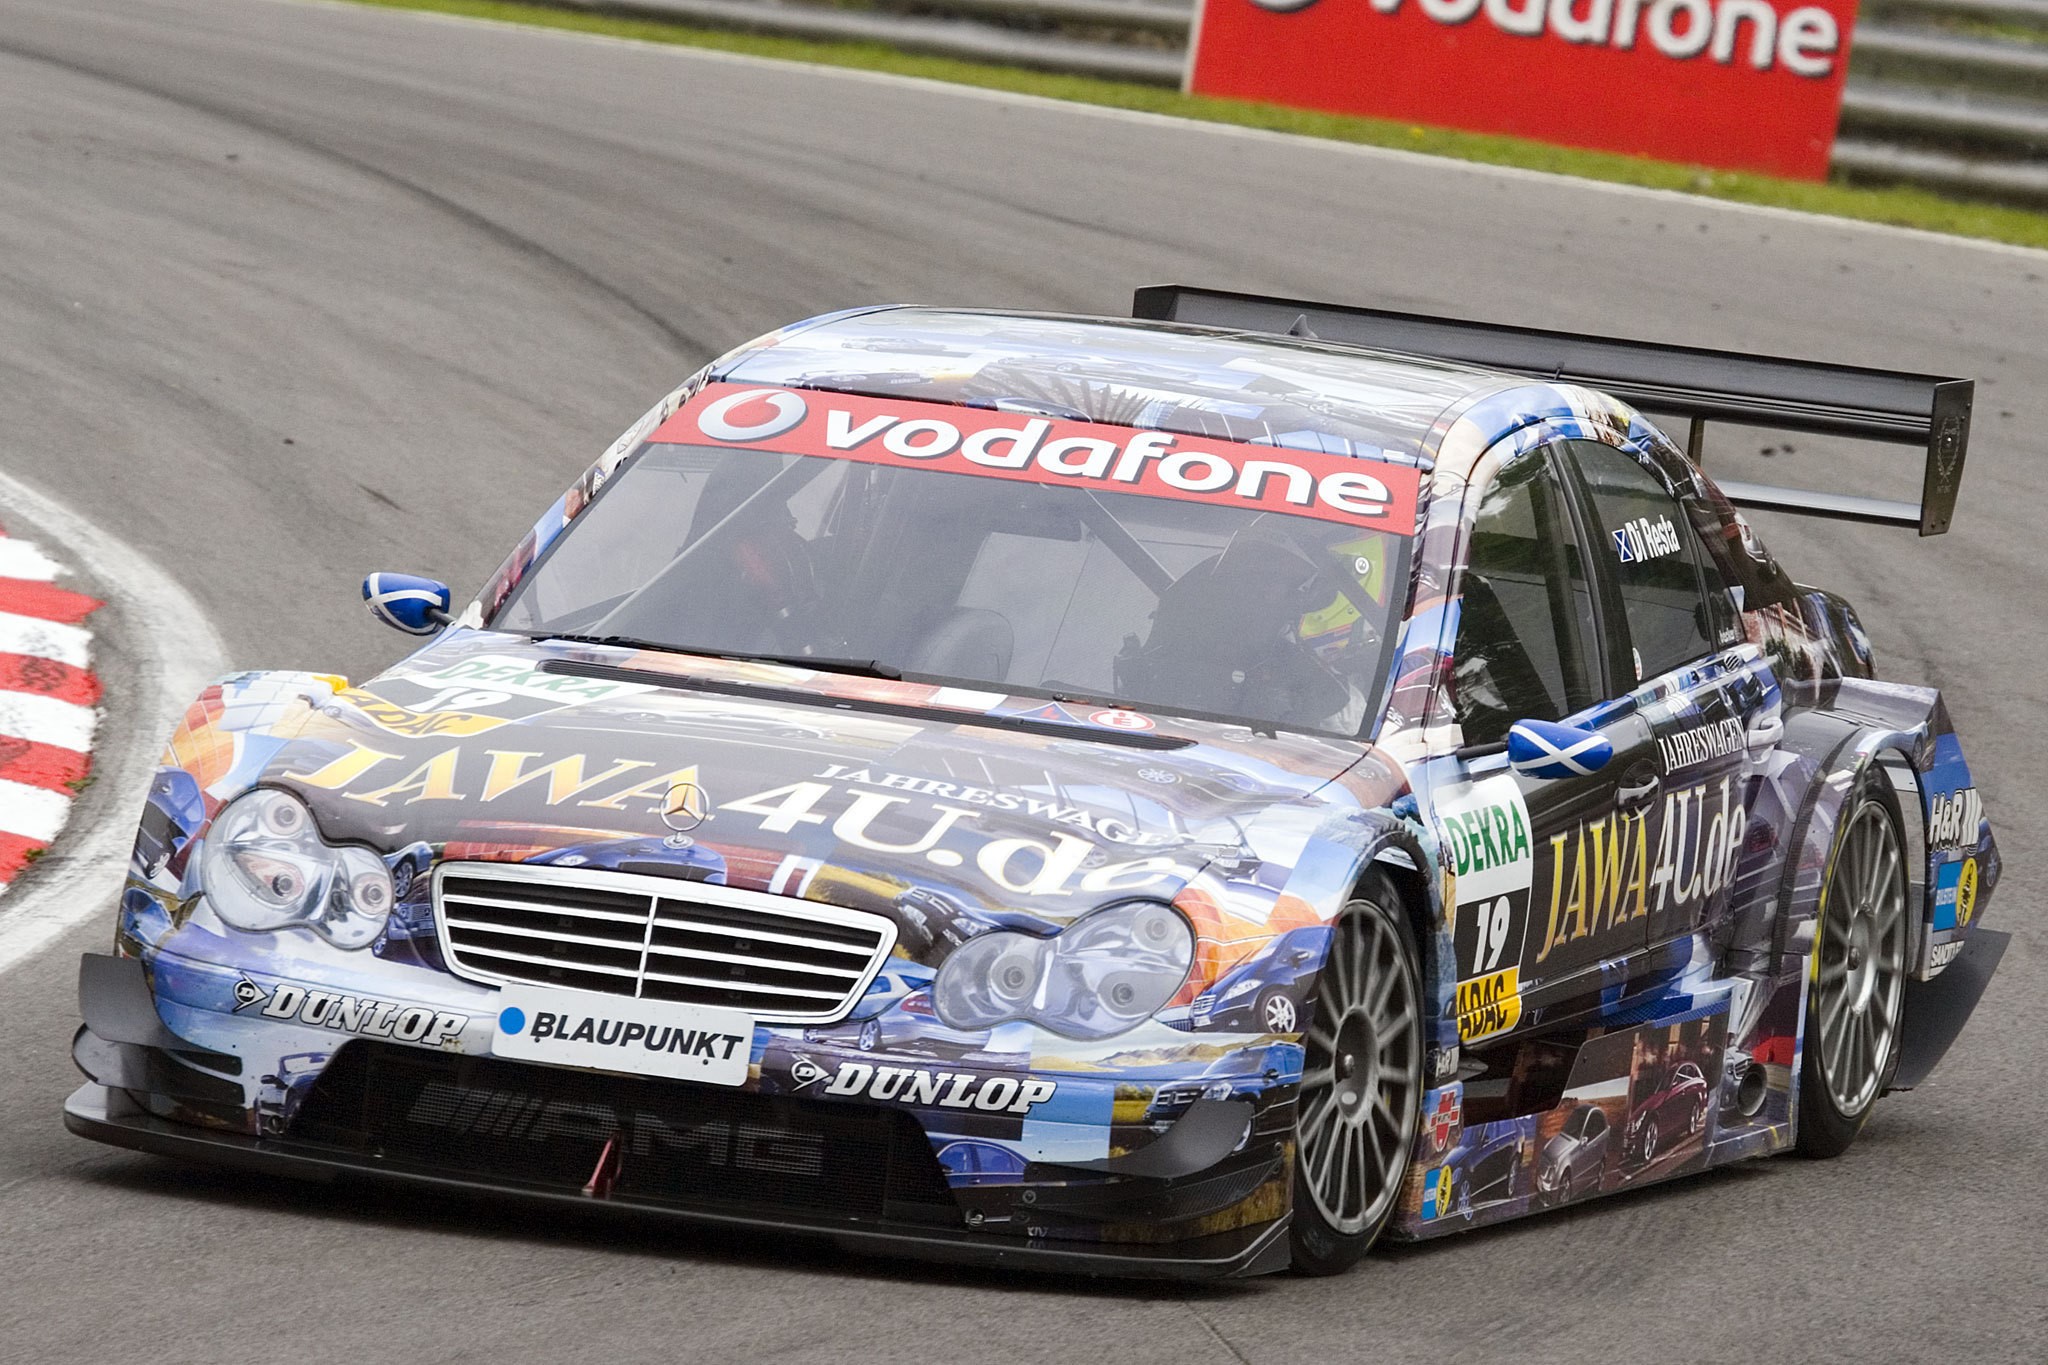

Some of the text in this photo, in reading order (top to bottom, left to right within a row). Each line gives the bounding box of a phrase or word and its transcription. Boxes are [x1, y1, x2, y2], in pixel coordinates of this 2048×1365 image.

[1367, 0, 1838, 76] afone
[826, 408, 1392, 515] vodafone
[1625, 514, 1681, 563] Di Resta
[404, 686, 512, 714] 19
[431, 660, 620, 699] DEKRA
[1657, 715, 1747, 777] JAHRESWAGEN
[813, 763, 1182, 845] JAHRESWAGE
[1929, 788, 1964, 844] H&R
[1443, 799, 1531, 877] DEKRA
[1472, 895, 1511, 974] 19
[261, 984, 470, 1047] DUNLOP
[530, 1011, 745, 1062] BLAUPUNKT
[1456, 974, 1508, 1039] ADAC
[824, 1061, 1058, 1114] DUNLOP
